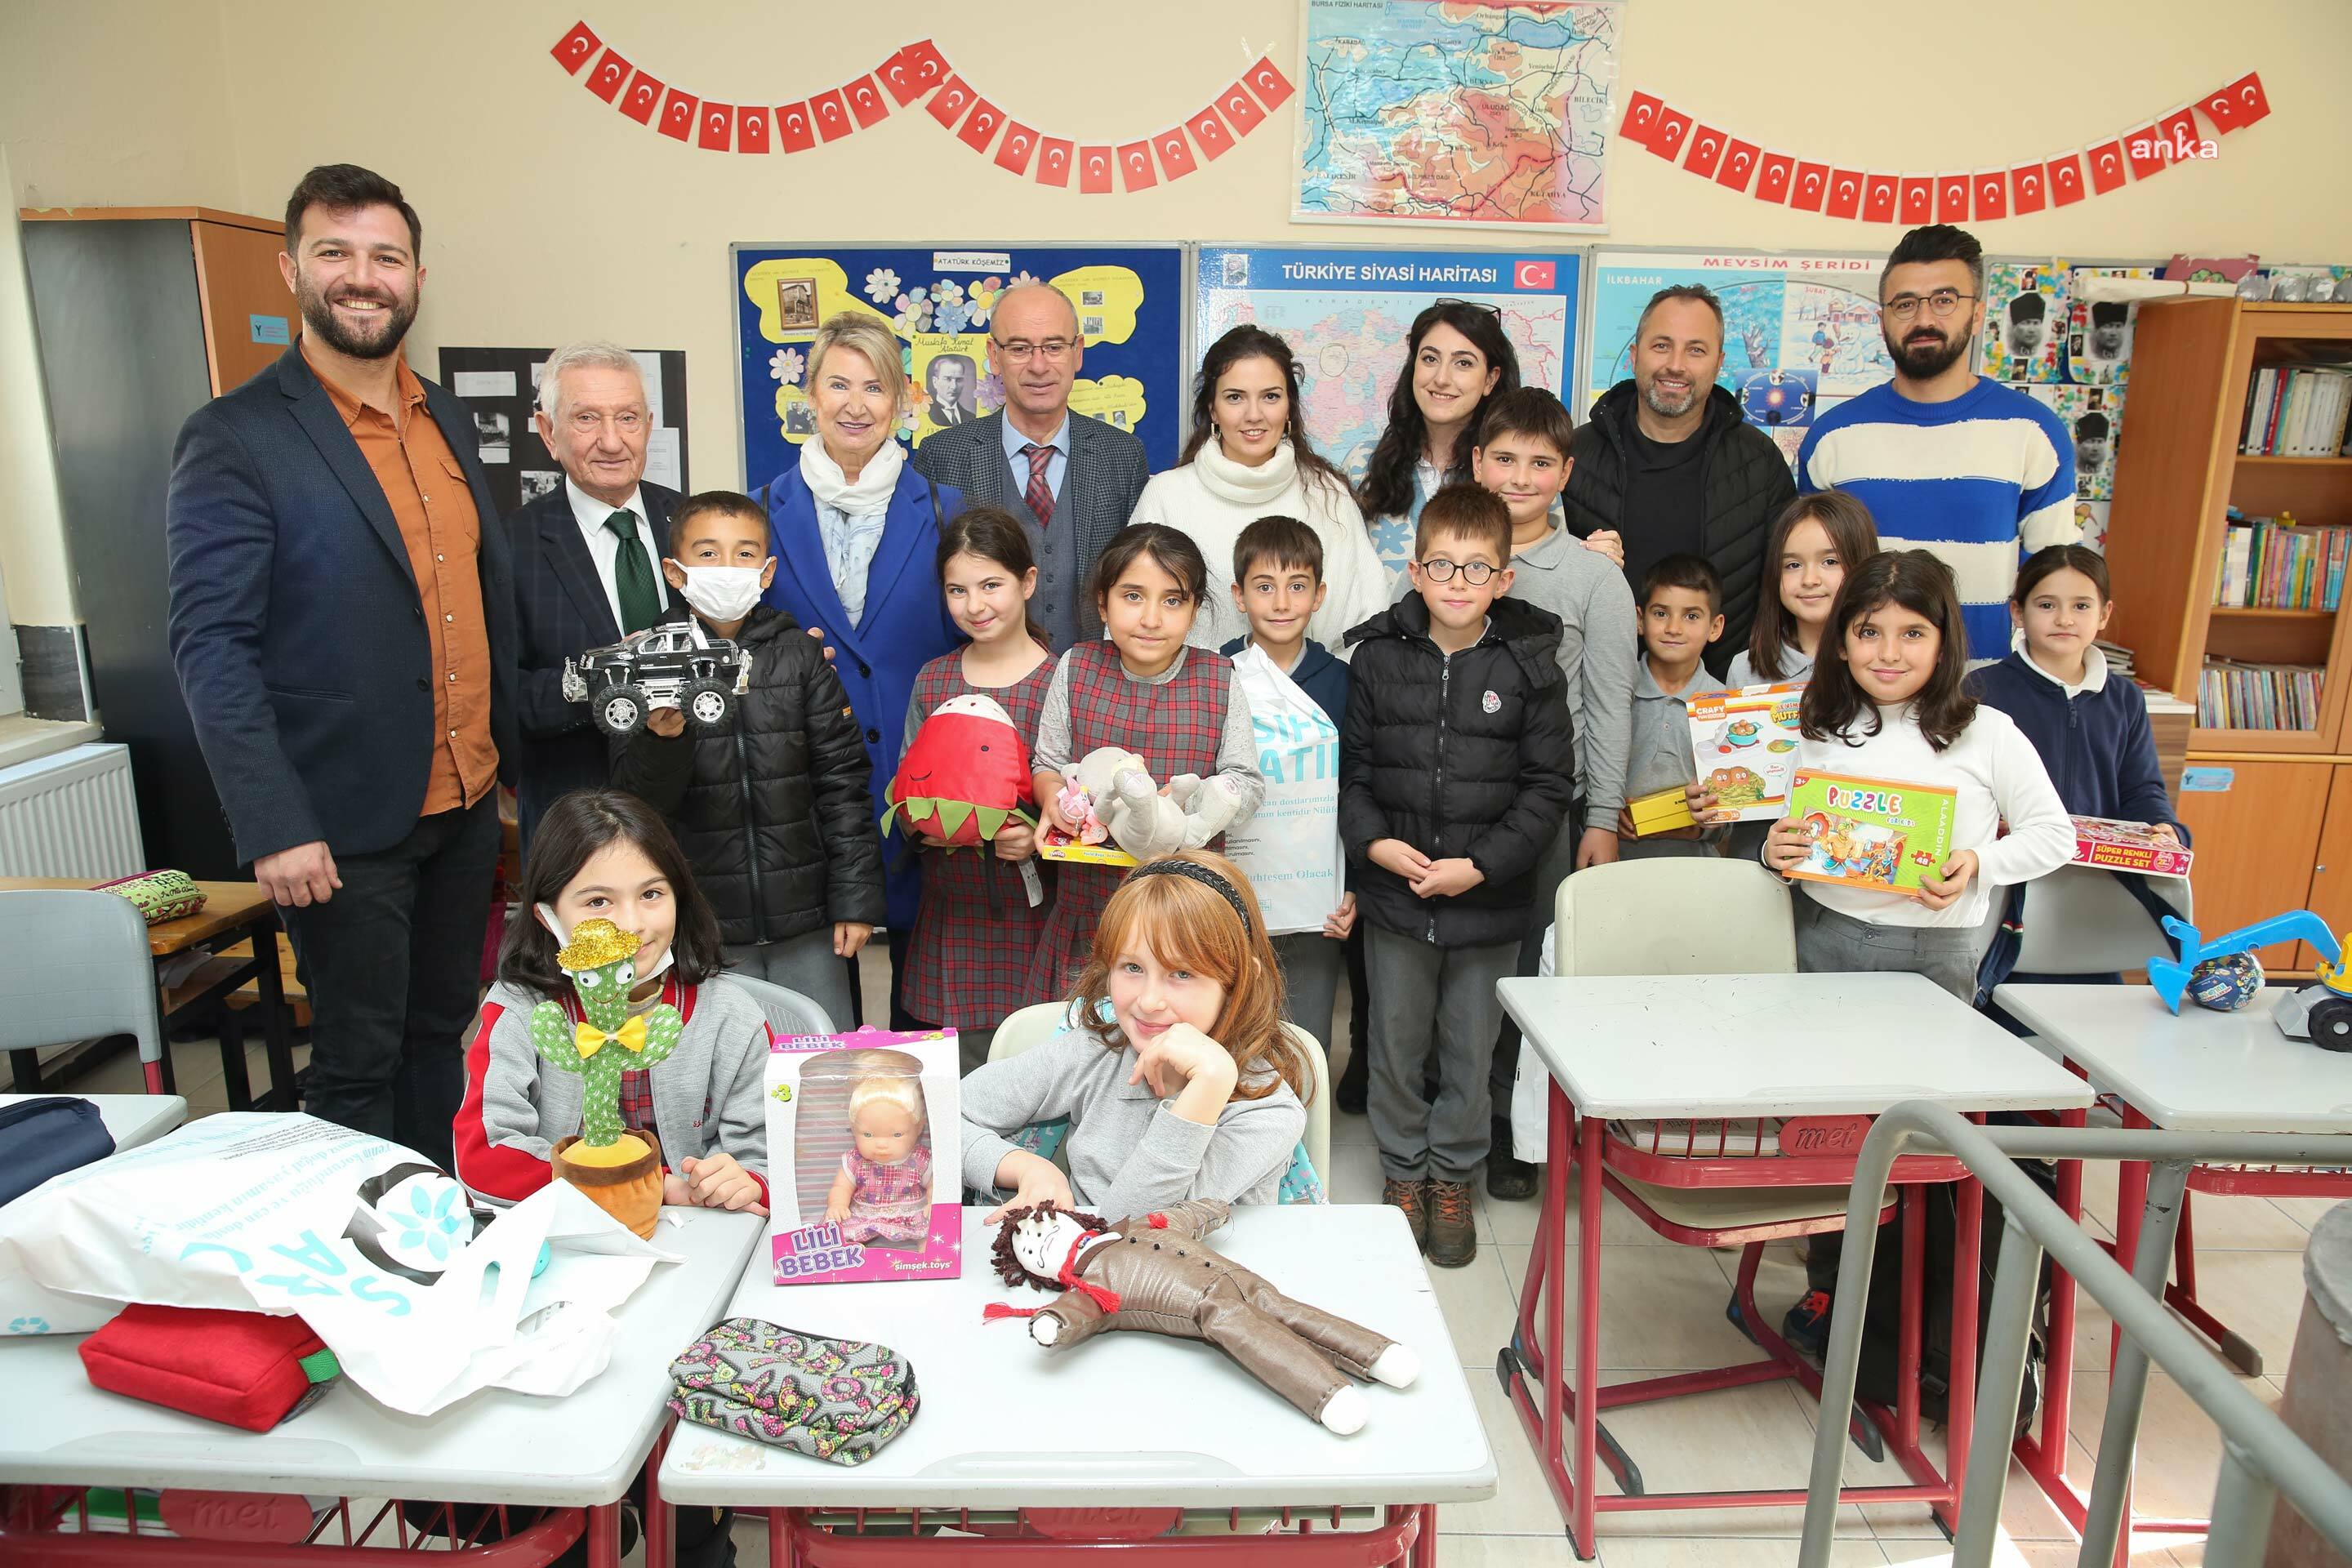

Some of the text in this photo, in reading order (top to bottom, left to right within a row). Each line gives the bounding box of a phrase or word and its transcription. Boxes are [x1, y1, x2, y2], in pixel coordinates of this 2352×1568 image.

[1481, 102, 1510, 111] ULUDAĞ
[1575, 96, 1604, 105] BİLECİK
[972, 258, 1005, 267] KÖŞEMİZ
[1704, 257, 1870, 270] MEVSİM ŞERİDİ
[1282, 261, 1497, 283] TÜRKİYE SİYASİ HARİTASI
[1606, 274, 1662, 285] İLKBAHAR
[916, 336, 948, 349] Mustafa
[1696, 706, 1725, 715] CRAFY
[1252, 708, 1339, 744] SIFI
[1280, 794, 1335, 806] dostlarımızla
[1828, 786, 1901, 814] PUZZLE
[1276, 808, 1311, 817] kentidir
[1936, 799, 1949, 856] ALAADDIN
[2096, 844, 2123, 855] SÜPER
[2123, 848, 2153, 859] RENKLİ
[1916, 857, 1928, 865] 48
[2094, 853, 2132, 866] PUZZLE
[2132, 858, 2152, 869] SET
[1296, 869, 1334, 880] Olacak
[781, 1041, 844, 1050] BEBEK
[1795, 1122, 1858, 1150] met
[794, 1223, 841, 1252] LİLİ
[780, 1245, 865, 1277] BEBEK
[895, 1261, 951, 1272] şimşek.toys
